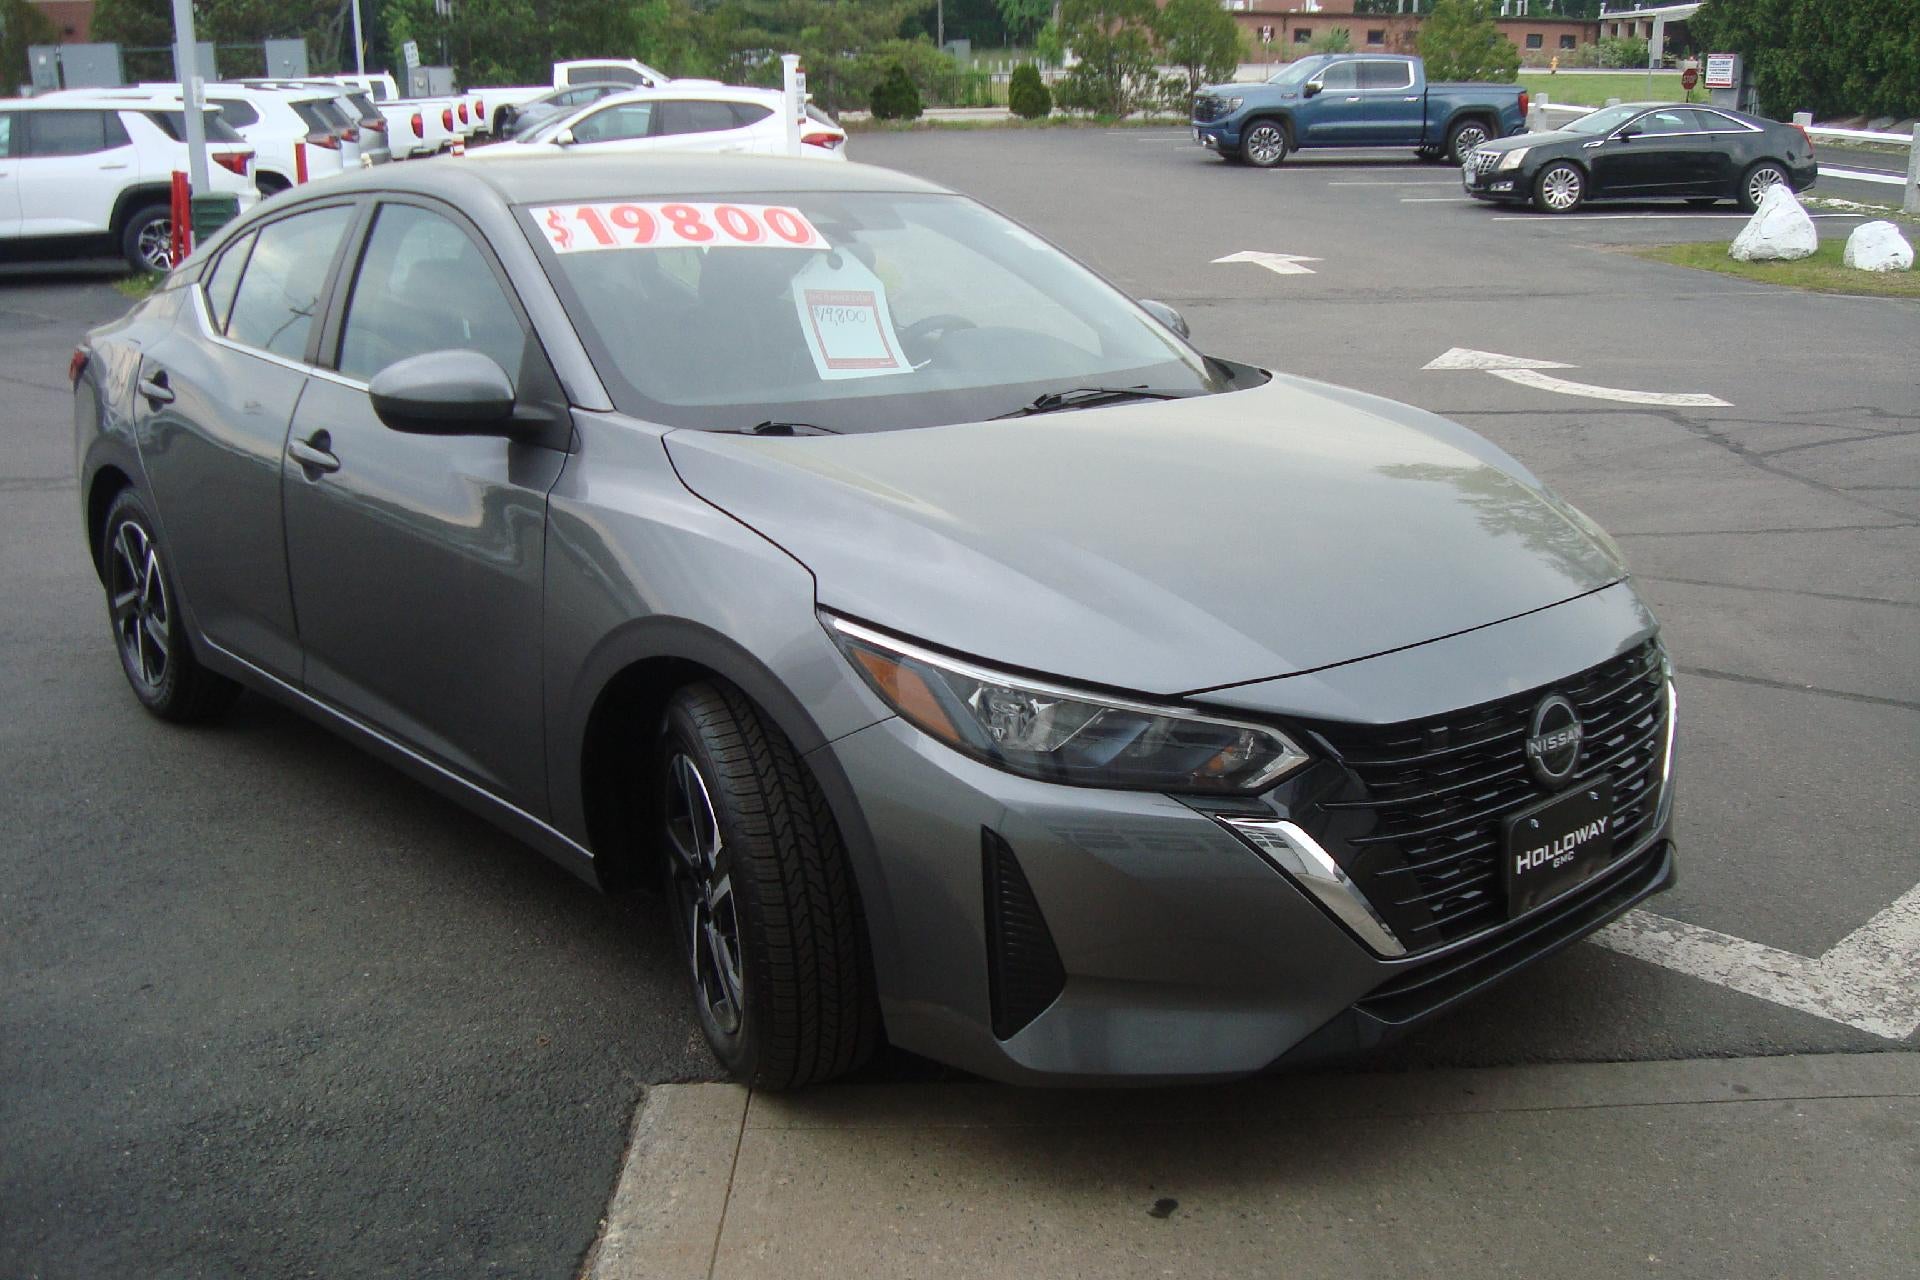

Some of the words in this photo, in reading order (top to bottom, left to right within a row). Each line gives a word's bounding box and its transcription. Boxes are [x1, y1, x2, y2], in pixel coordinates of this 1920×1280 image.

[1682, 75, 1697, 84] STOP
[547, 204, 816, 248] $19800
[1528, 724, 1582, 755] NISSAN
[1516, 816, 1609, 874] HOLLOWAY
[1552, 850, 1575, 869] GMC
